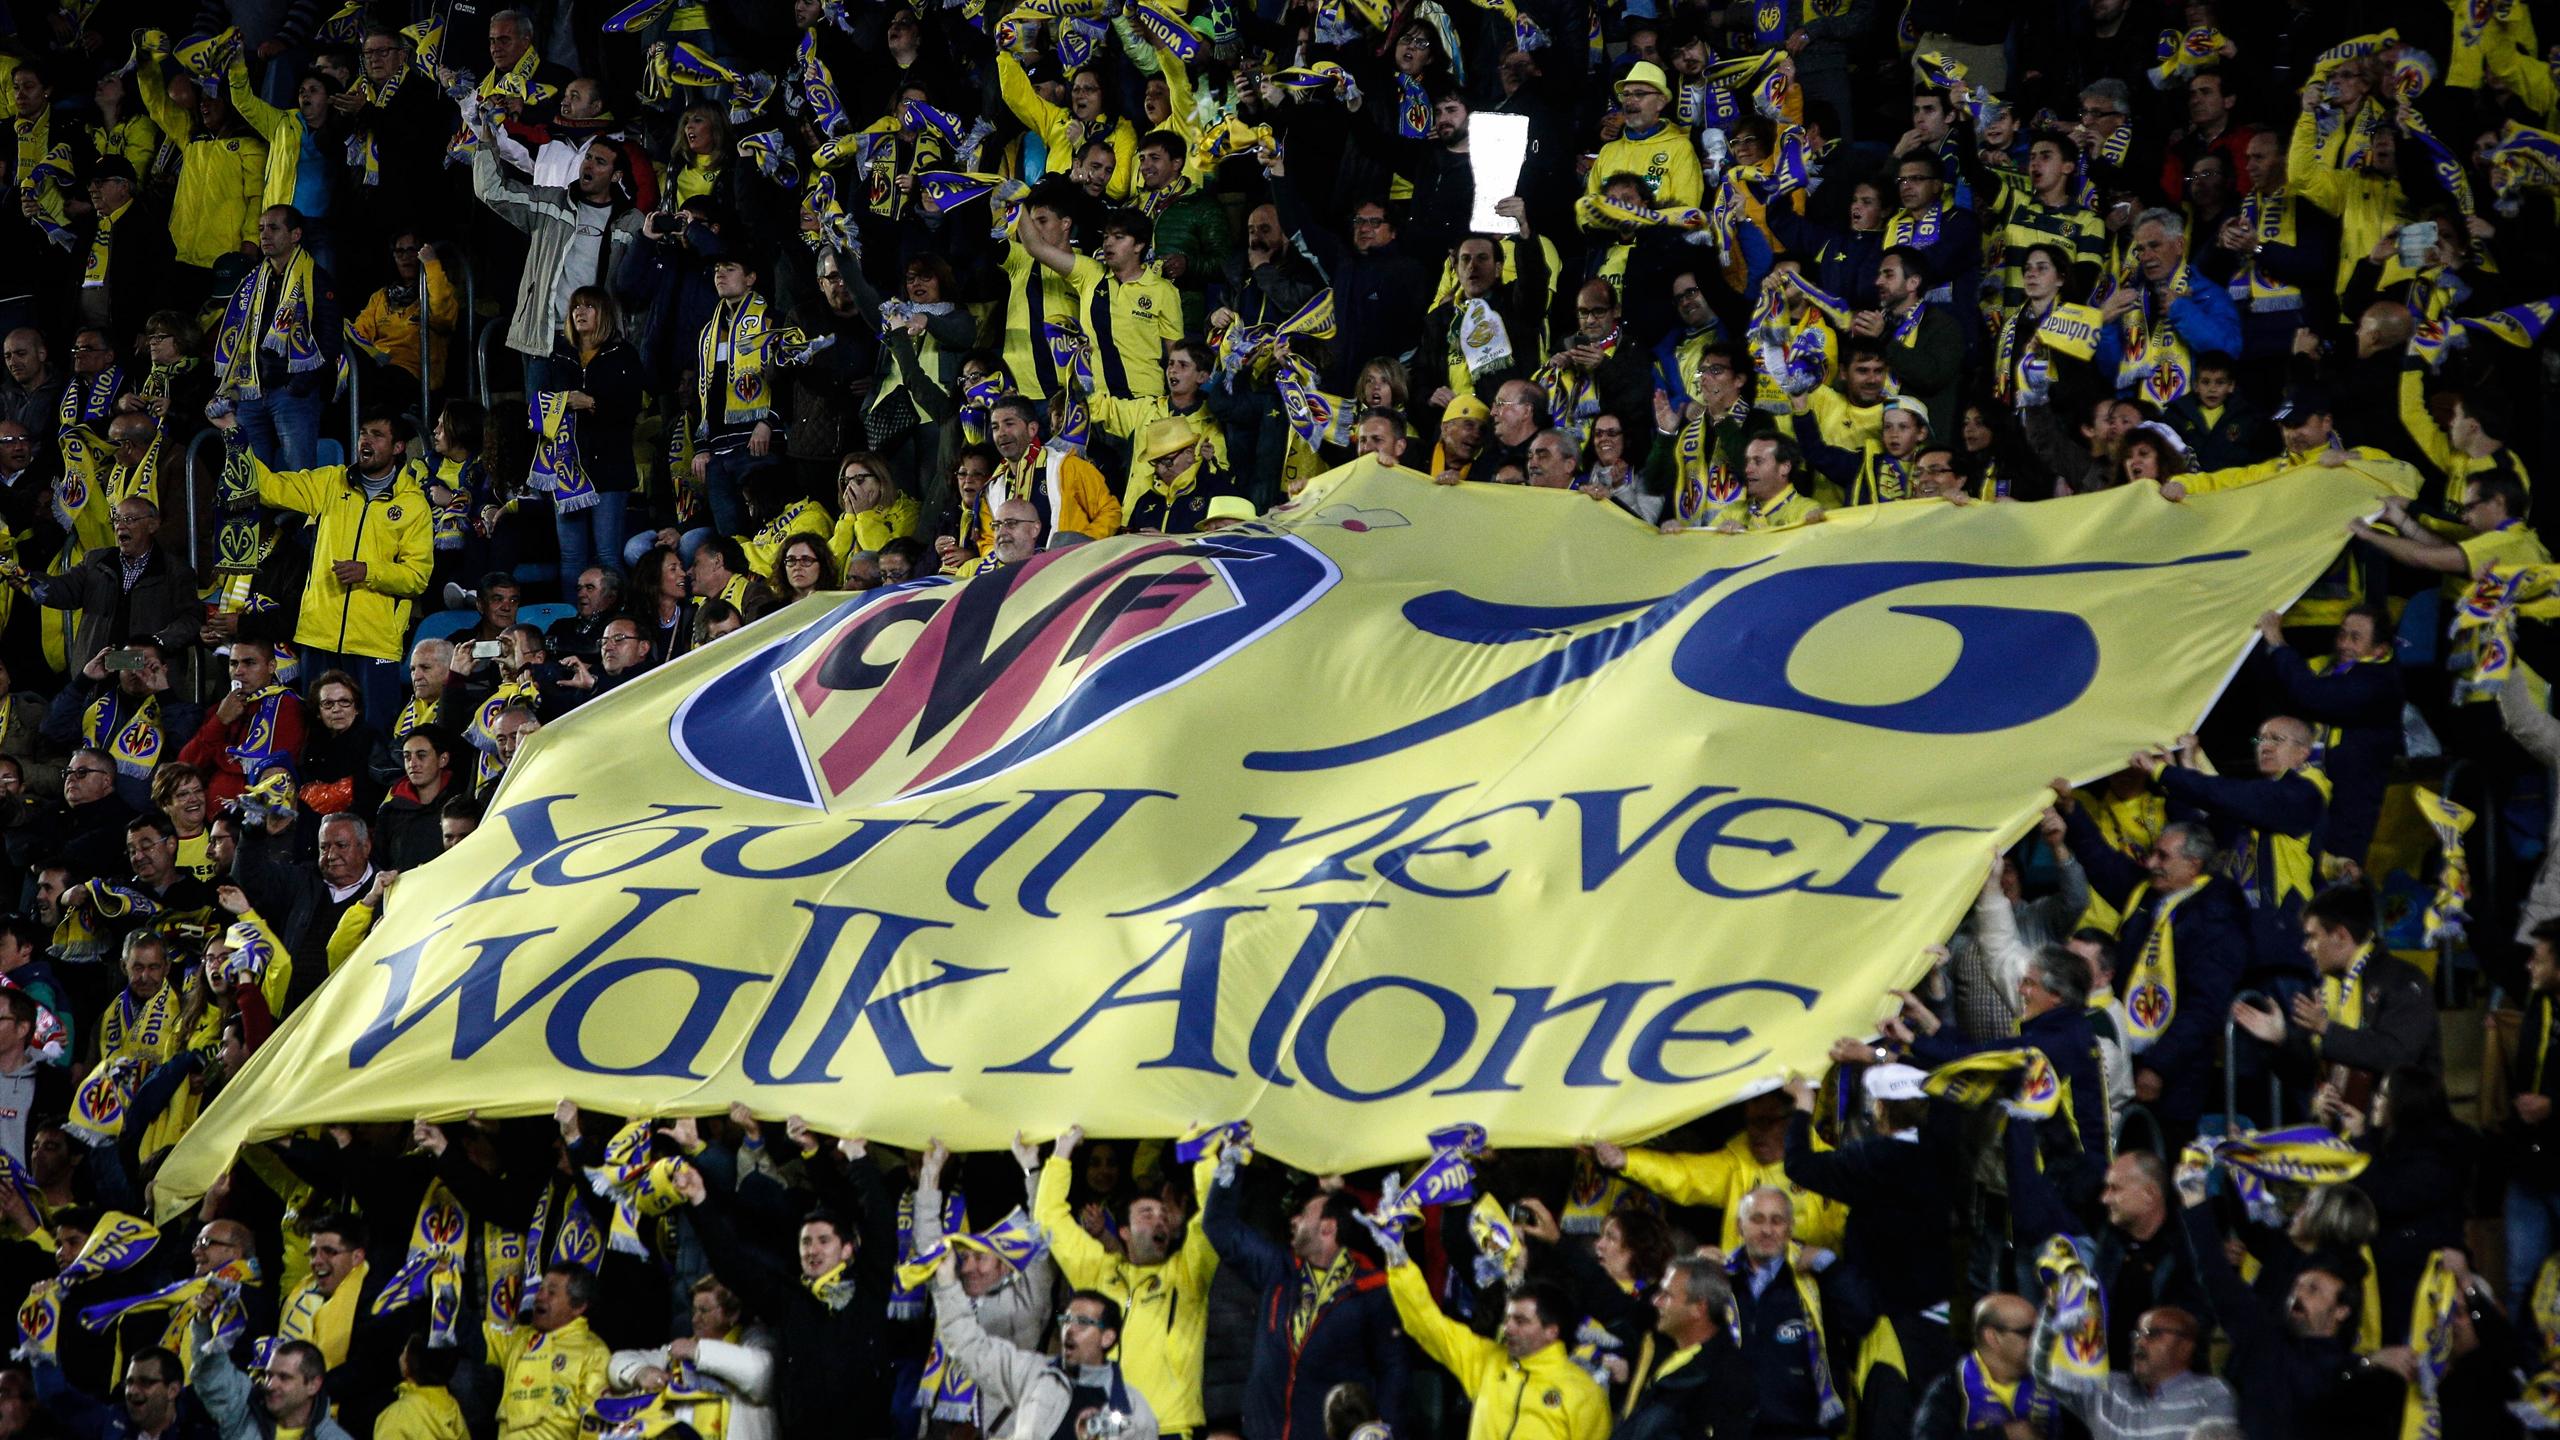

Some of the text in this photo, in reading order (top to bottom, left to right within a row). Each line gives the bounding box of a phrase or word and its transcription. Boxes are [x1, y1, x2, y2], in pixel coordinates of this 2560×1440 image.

[1243, 549, 2252, 772] 76
[436, 788, 1178, 919] You'll
[348, 886, 1822, 1102] Walk Alone
